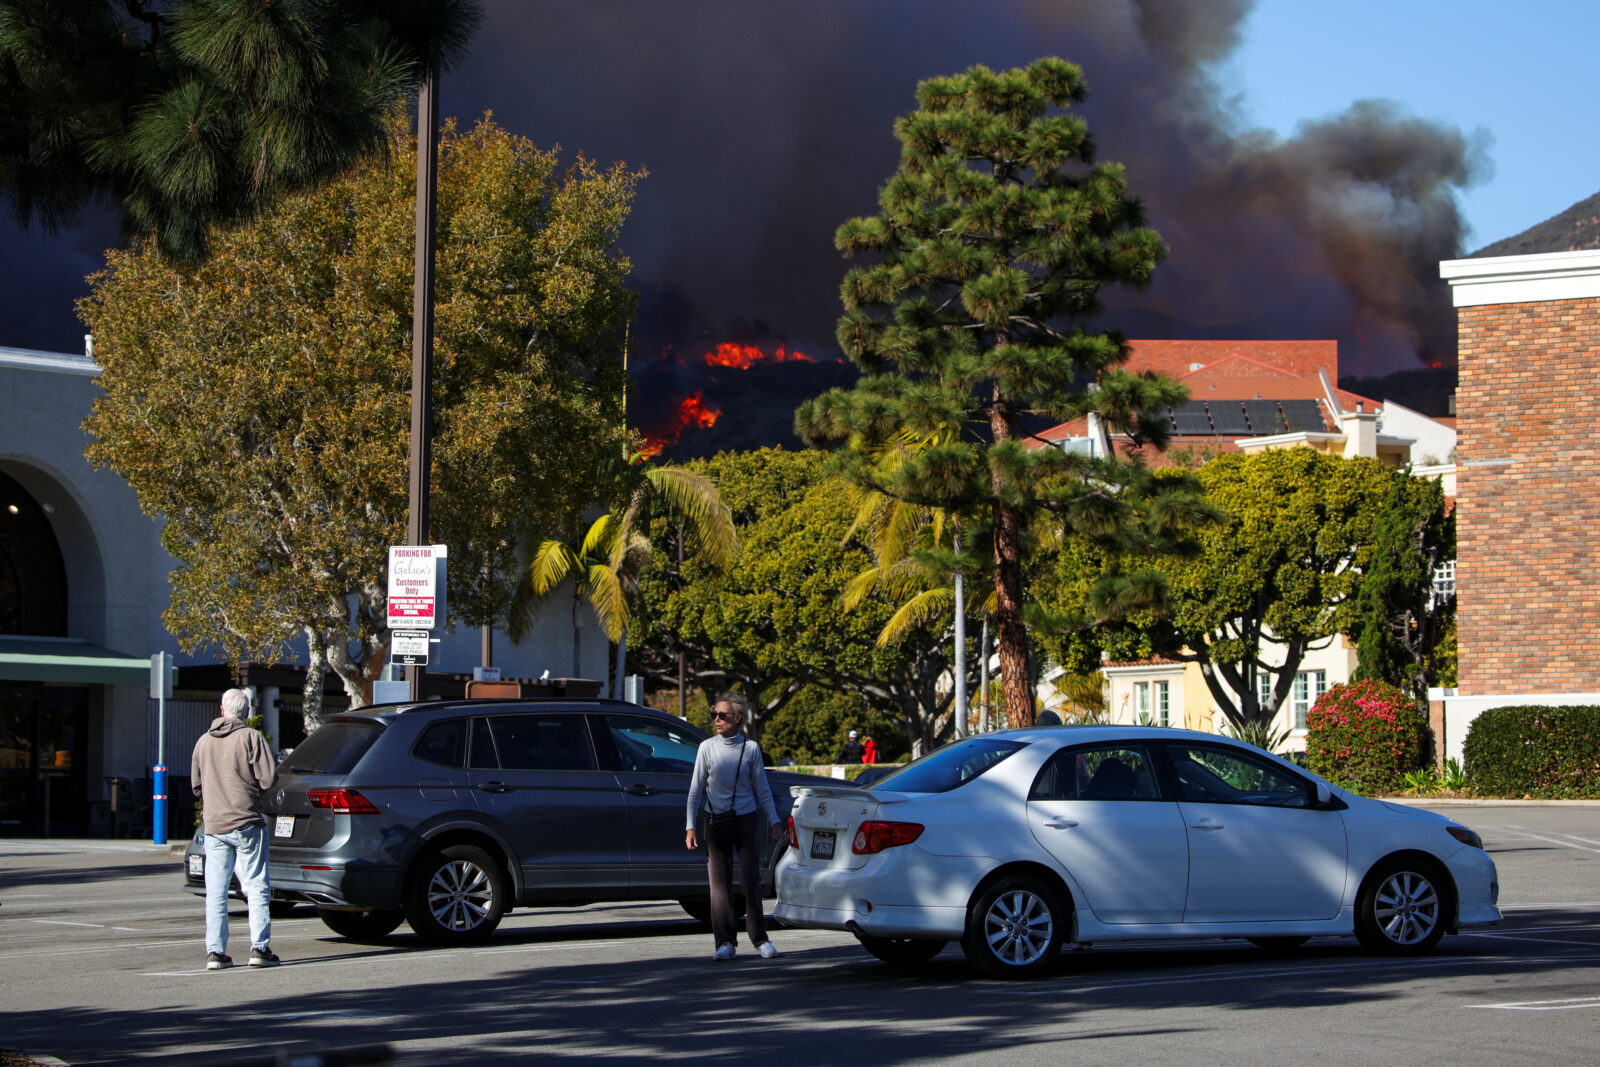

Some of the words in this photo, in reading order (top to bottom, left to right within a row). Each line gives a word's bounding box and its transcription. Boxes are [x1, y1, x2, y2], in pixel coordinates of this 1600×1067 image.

[394, 549, 419, 557] PARKING
[420, 549, 431, 557] FOR
[394, 559, 431, 577] Gelson's
[396, 578, 428, 587] Customers
[405, 587, 418, 595] Only
